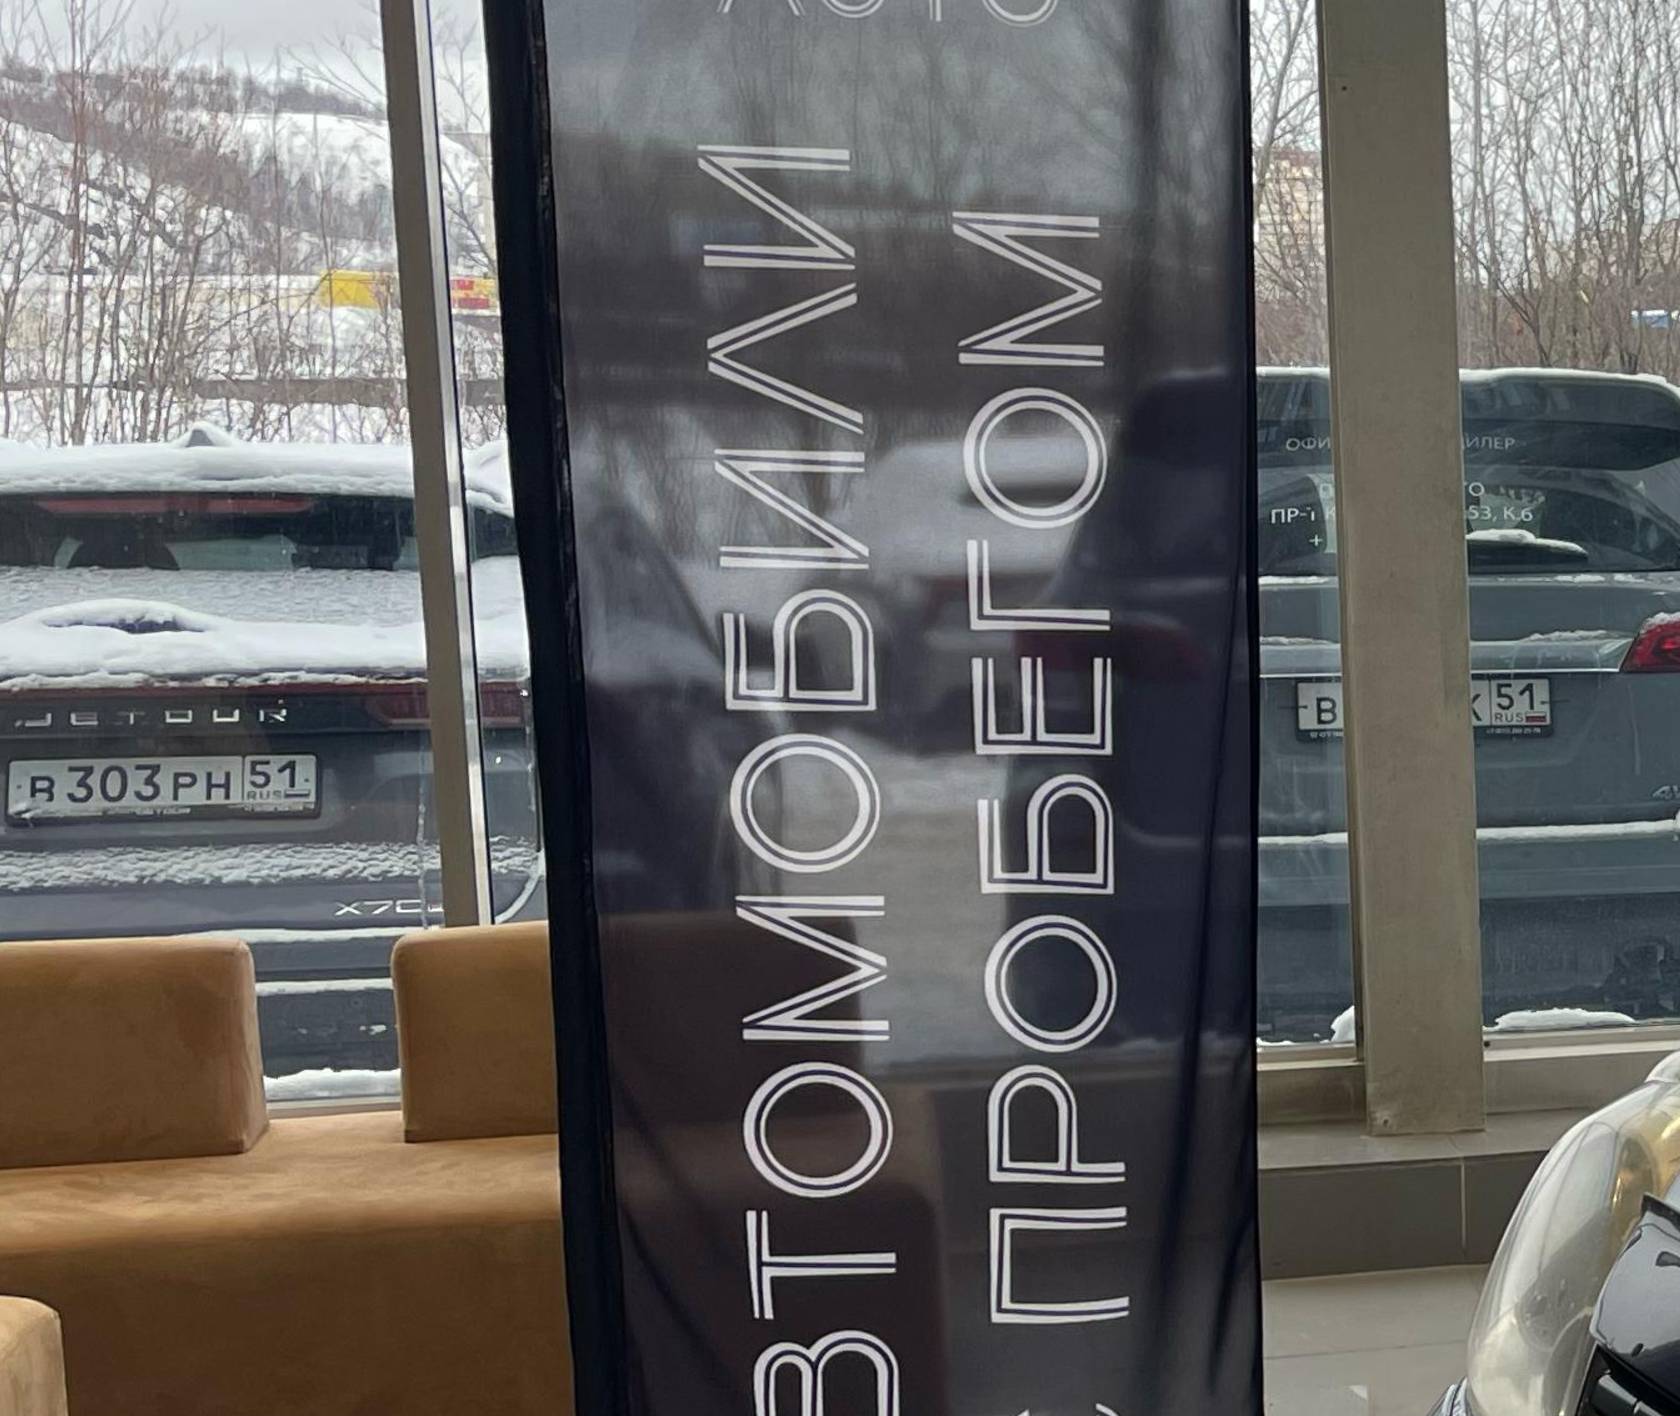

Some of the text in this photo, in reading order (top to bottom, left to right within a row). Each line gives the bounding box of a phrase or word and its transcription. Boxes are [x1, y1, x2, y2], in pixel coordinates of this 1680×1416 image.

[1464, 433, 1516, 450] ИЛЕР
[1496, 682, 1535, 711] 51
[1494, 713, 1524, 723] RUS
[249, 759, 297, 789] 51
[952, 210, 1131, 1325] ПРОБЕГОМ
